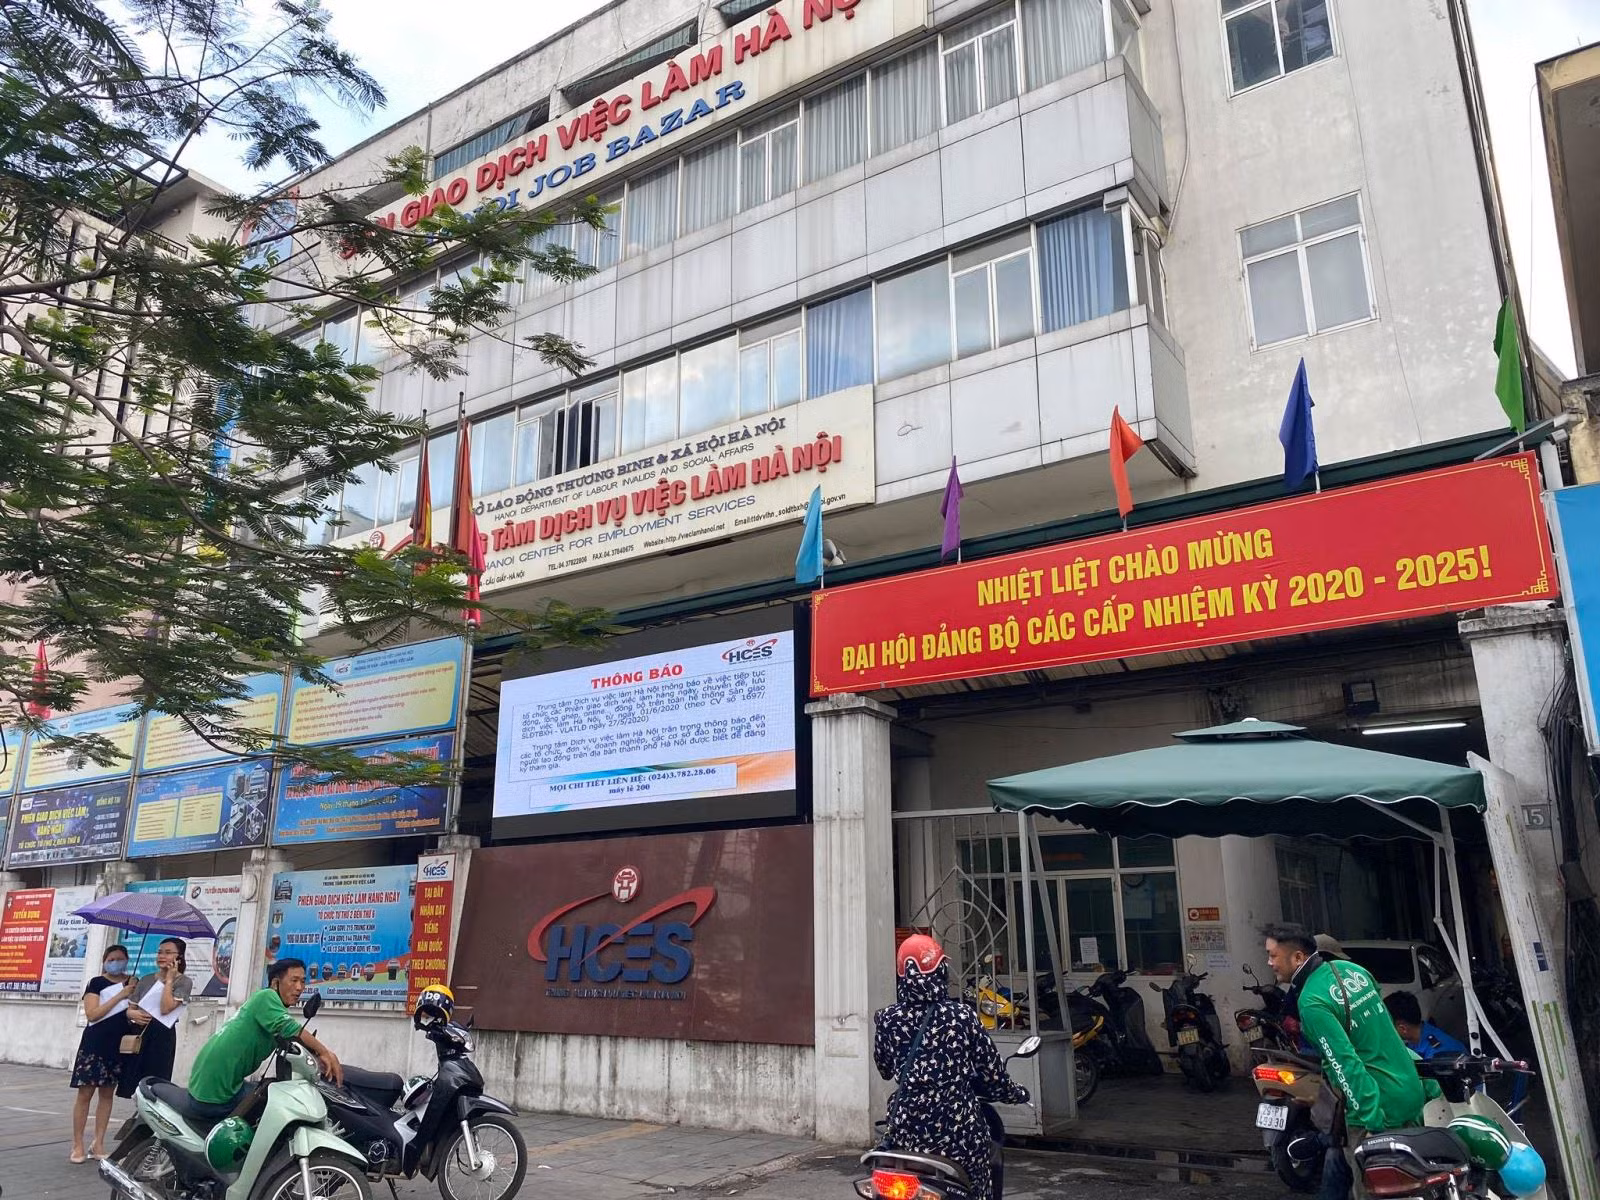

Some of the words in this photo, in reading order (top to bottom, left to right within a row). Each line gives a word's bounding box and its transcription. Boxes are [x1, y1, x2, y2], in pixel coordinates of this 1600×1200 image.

[401, 177, 468, 228] GIAO
[476, 134, 548, 192] DỊCH
[557, 95, 632, 150] VIỆC
[640, 44, 723, 111] LÀM
[734, 8, 792, 65] HÀ
[528, 152, 596, 199] JOB
[606, 79, 746, 162] BAZAR
[487, 497, 513, 512] LAO
[515, 485, 553, 504] ĐỘNG
[556, 468, 614, 492] THƯƠNG
[617, 456, 653, 475] BINH
[656, 453, 667, 464] &
[670, 442, 692, 460] XÃ
[696, 434, 725, 453] HỘI
[727, 425, 752, 444] HÀ
[754, 417, 785, 436] NỘI
[491, 519, 535, 551] TÂM
[539, 504, 593, 541] DỊCH
[596, 495, 627, 526] VỤ
[631, 478, 686, 516] VIỆC
[690, 462, 746, 500] LÀM
[750, 445, 788, 485] HÀ
[792, 431, 841, 474] NỘI
[494, 509, 517, 521] HANOI
[520, 494, 568, 514] DEPARTMENT
[572, 490, 582, 500] OF
[586, 481, 617, 496] LABOUR
[622, 470, 655, 486] INVALIDS
[660, 464, 677, 475] AND
[683, 454, 713, 469] SOCIAL
[718, 442, 753, 459] AFFAIRS
[519, 543, 563, 562] CENTER
[569, 536, 592, 550] FOR
[598, 513, 681, 543] EMPLOYMENT
[687, 494, 755, 520] SERVICES
[977, 567, 1044, 607] NHIỆT
[1051, 555, 1101, 596] LIỆT
[1108, 544, 1179, 584] CHÀO
[1187, 528, 1274, 570] MỪNG
[841, 643, 875, 675] ĐẠI
[881, 633, 916, 669] HỘI
[922, 622, 982, 661] ĐẢNG
[988, 615, 1020, 654] BỘ
[1027, 609, 1076, 646] CÁC
[1083, 593, 1135, 637] CẤP
[1143, 585, 1235, 628] NHIỆM
[1241, 573, 1279, 614] KỲ
[1289, 566, 1364, 607] 2020
[1374, 575, 1386, 585] -
[1395, 544, 1493, 592] 2025!
[590, 671, 642, 688] THÔNG
[649, 663, 682, 679] BÁO
[728, 645, 772, 662] HCES
[568, 781, 583, 789] CHI
[586, 779, 605, 787] TIẾT
[607, 776, 627, 785] LIÊN
[636, 783, 650, 791] 200
[1523, 809, 1544, 826] 15
[544, 922, 694, 983] HCES
[425, 992, 440, 1000] be
[1367, 1136, 1396, 1146] HONDA
